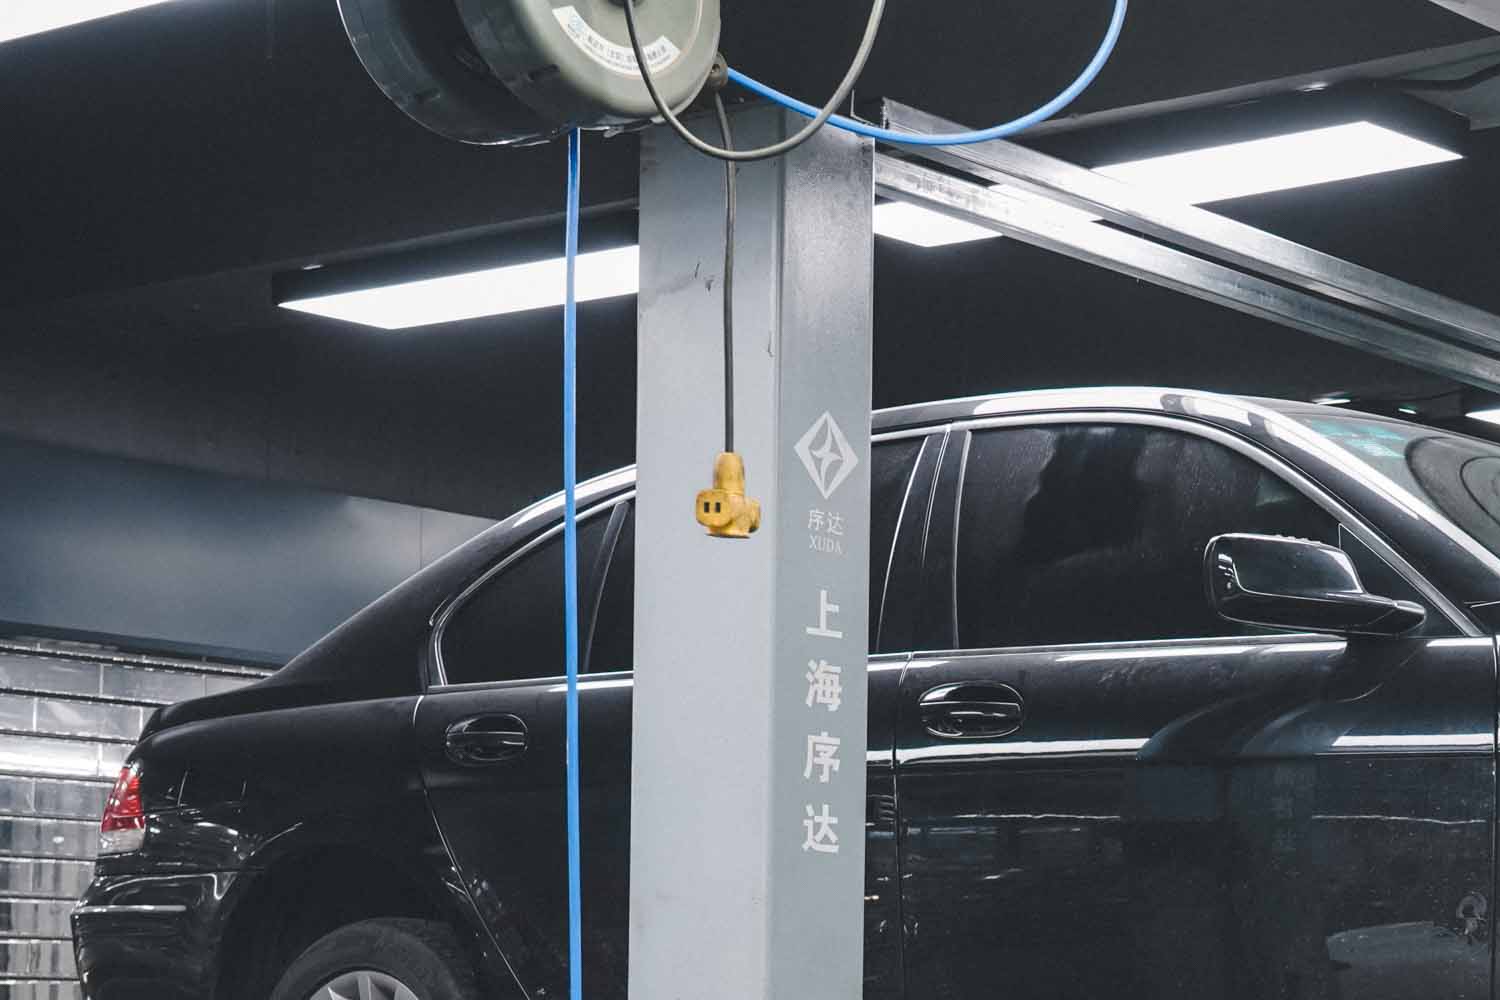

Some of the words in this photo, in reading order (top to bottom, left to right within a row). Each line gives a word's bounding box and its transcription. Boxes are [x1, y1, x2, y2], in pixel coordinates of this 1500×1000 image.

[808, 508, 843, 535] 序达
[808, 534, 842, 554] XUDA
[802, 590, 843, 854] 上海序达
